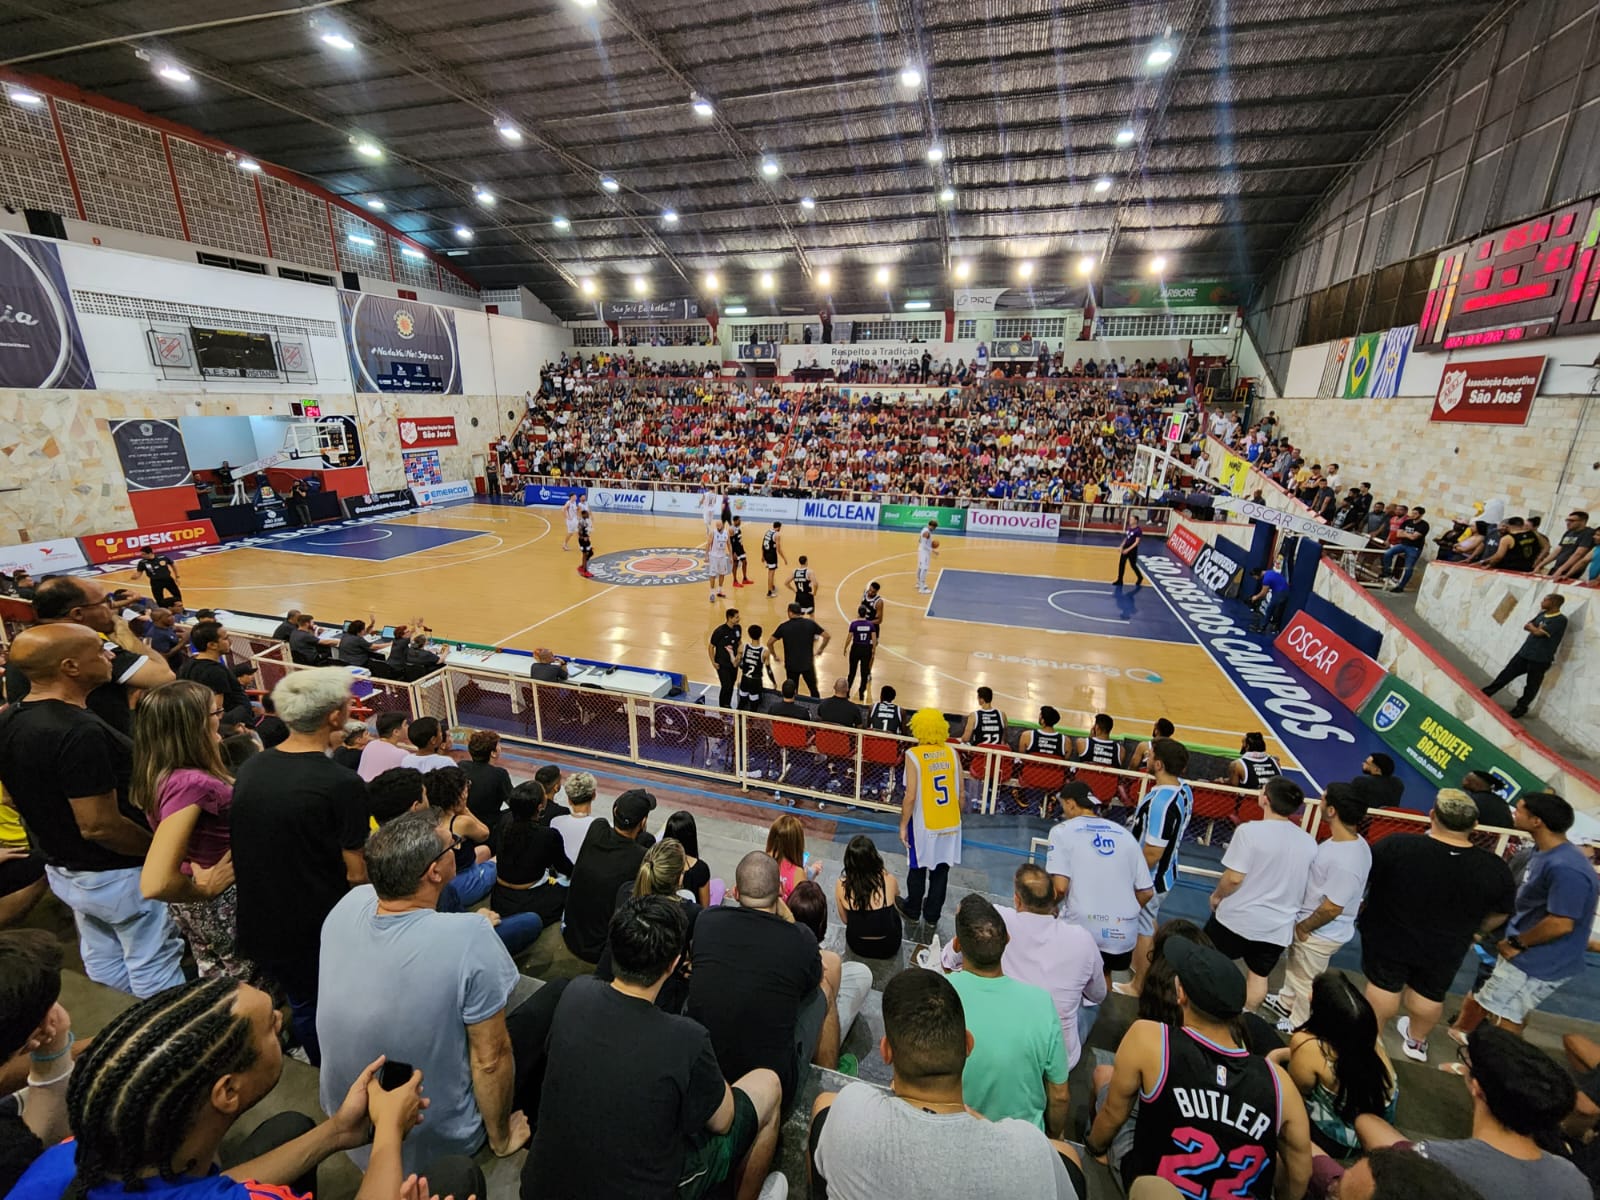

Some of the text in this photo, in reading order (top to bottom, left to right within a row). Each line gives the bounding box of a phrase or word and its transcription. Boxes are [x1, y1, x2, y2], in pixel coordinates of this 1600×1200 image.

[970, 296, 992, 304] PRC
[880, 347, 919, 357] Tradição
[1466, 375, 1535, 388] Associação Esportiva
[1469, 389, 1491, 404] São
[1491, 387, 1522, 404] José
[423, 430, 451, 439] São José
[430, 486, 468, 498] EMERCOR
[614, 493, 646, 503] VINAC
[804, 502, 876, 521] MILCLEAN
[970, 511, 1057, 530] Tomovale
[1242, 503, 1339, 540] OSCAR OSCAR
[126, 527, 206, 549] DESKTOP
[1154, 573, 1224, 604] JOSÉ
[1178, 602, 1247, 636] DOS
[1288, 625, 1340, 674] OSCAR
[744, 665, 755, 679] 2
[1210, 637, 1356, 743] CAMPOS
[1420, 716, 1473, 762] BASQUETE
[1416, 735, 1453, 770] BRASIL
[933, 774, 950, 806] 5
[1173, 1087, 1271, 1140] BUTLER
[1156, 1126, 1270, 1200] 22
